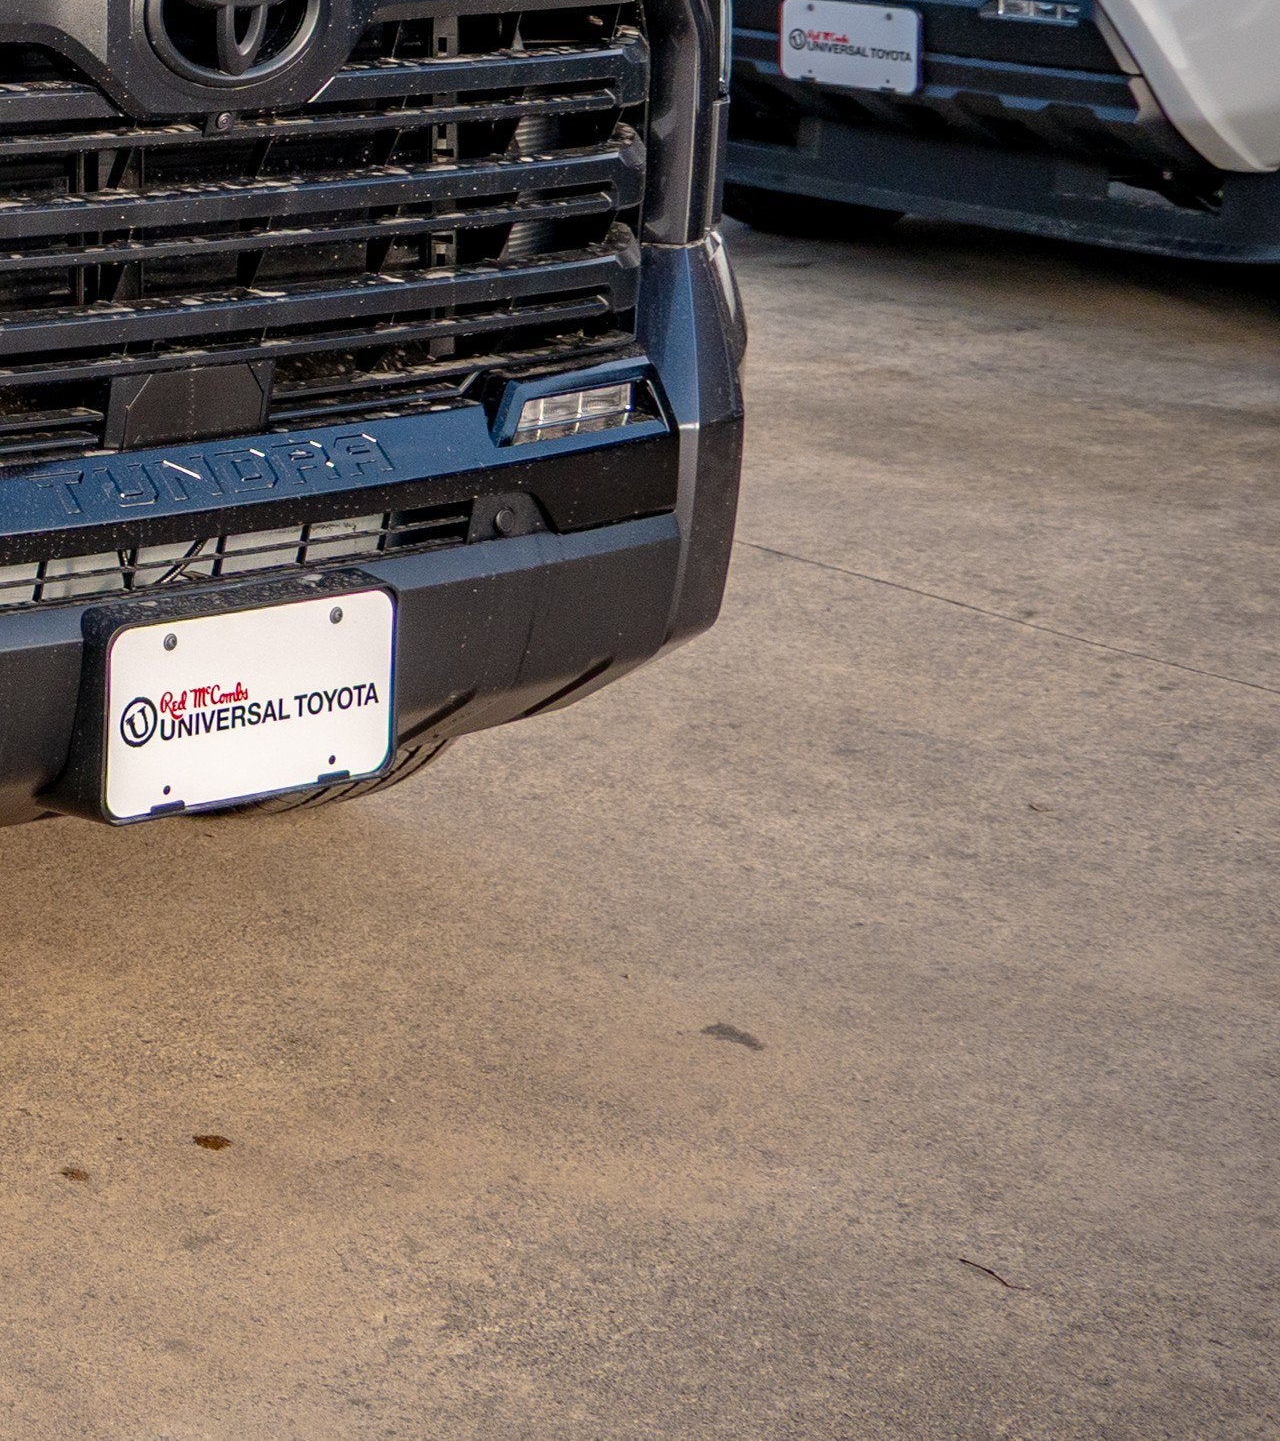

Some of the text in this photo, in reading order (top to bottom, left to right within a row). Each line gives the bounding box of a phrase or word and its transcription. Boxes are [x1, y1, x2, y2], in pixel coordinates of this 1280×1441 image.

[806, 41, 912, 63] UNIVERSAL TOYOTA
[26, 432, 396, 516] TUNDRA
[160, 691, 187, 720] Red
[160, 682, 379, 741] UNIVERSAL TOYOTA
